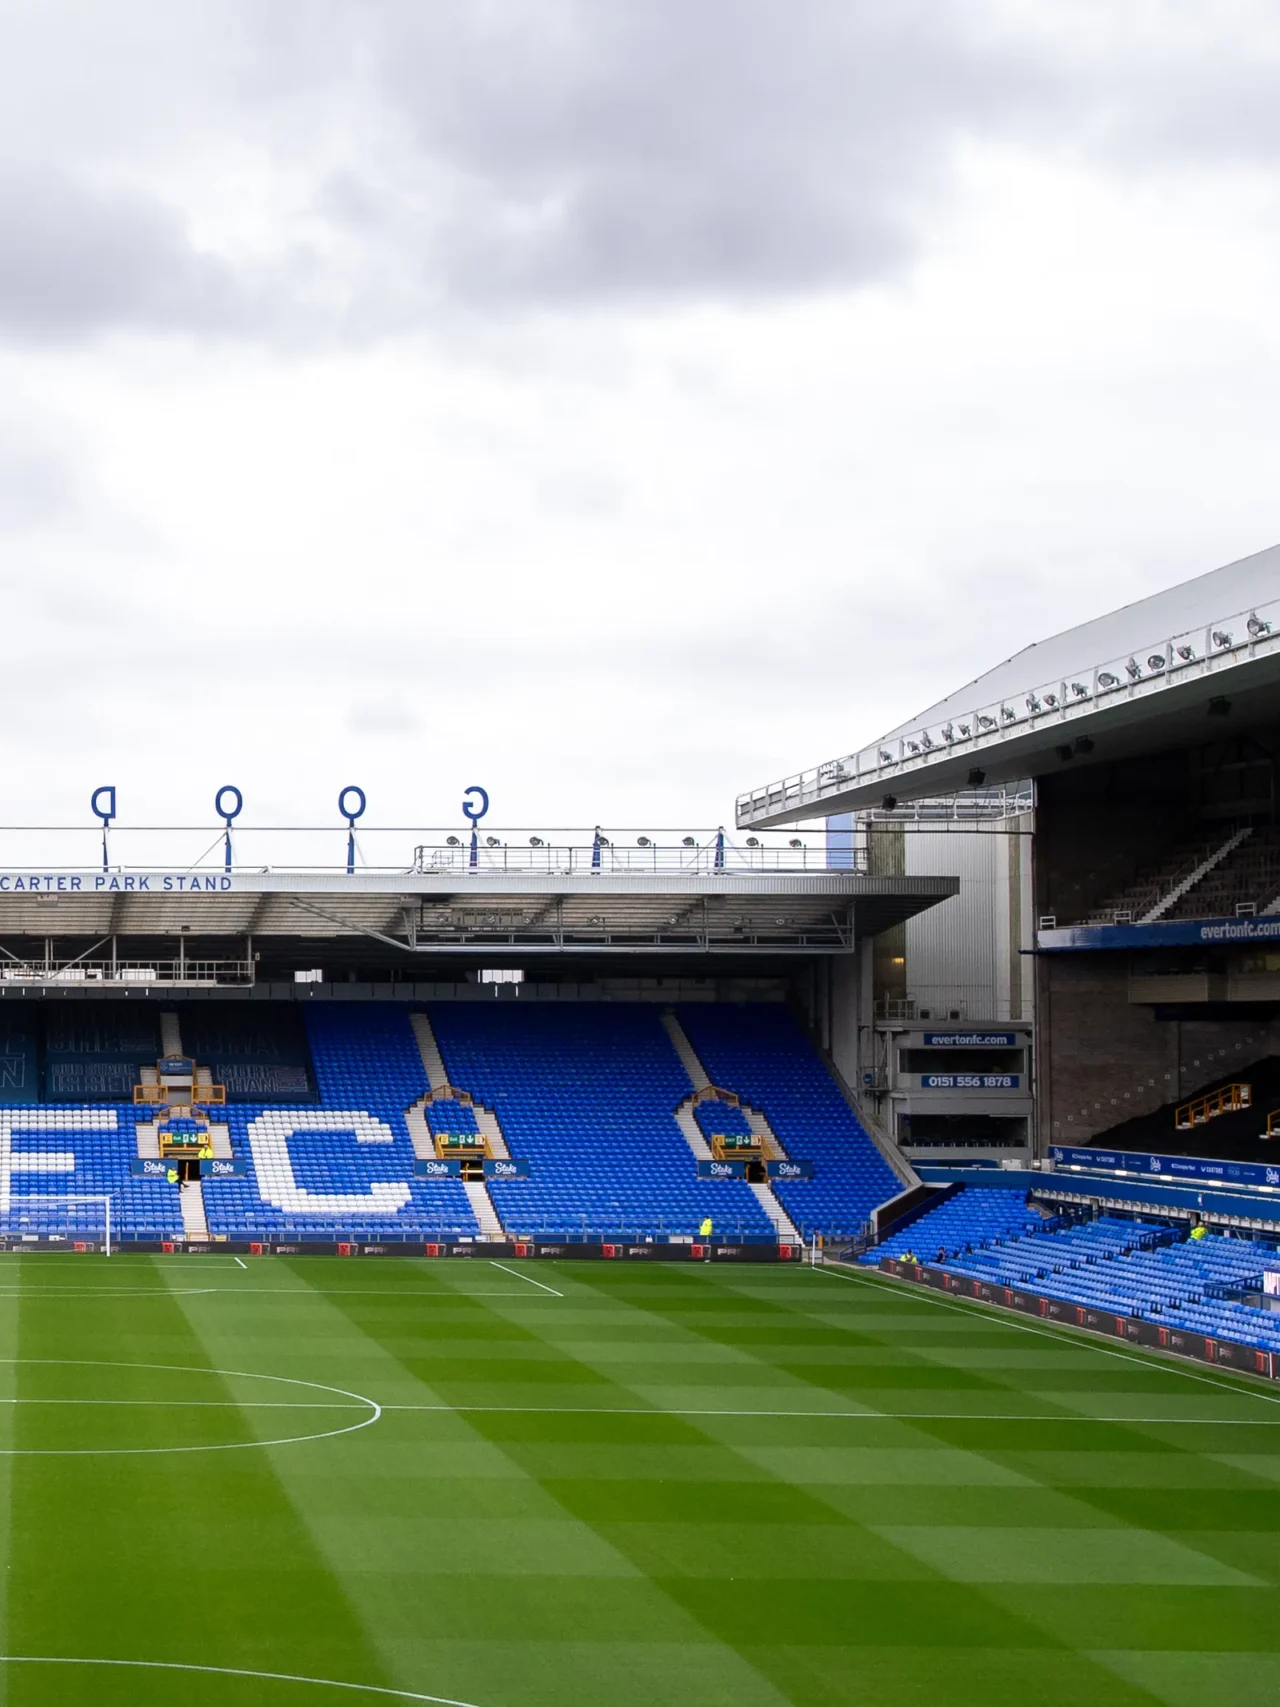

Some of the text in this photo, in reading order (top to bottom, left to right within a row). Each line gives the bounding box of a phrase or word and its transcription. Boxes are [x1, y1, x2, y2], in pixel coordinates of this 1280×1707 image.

[0, 878, 82, 891] CARTER
[95, 878, 150, 891] PARK
[163, 877, 232, 891] STAND
[932, 1035, 1007, 1044] evertonfc.com
[928, 1076, 1011, 1087] 0151 556 1878
[143, 1161, 166, 1173] Stake
[212, 1161, 234, 1173] Stake
[426, 1162, 449, 1174] Stake
[495, 1162, 517, 1174] Stake
[710, 1162, 733, 1175] Stake
[779, 1162, 801, 1175] Stake
